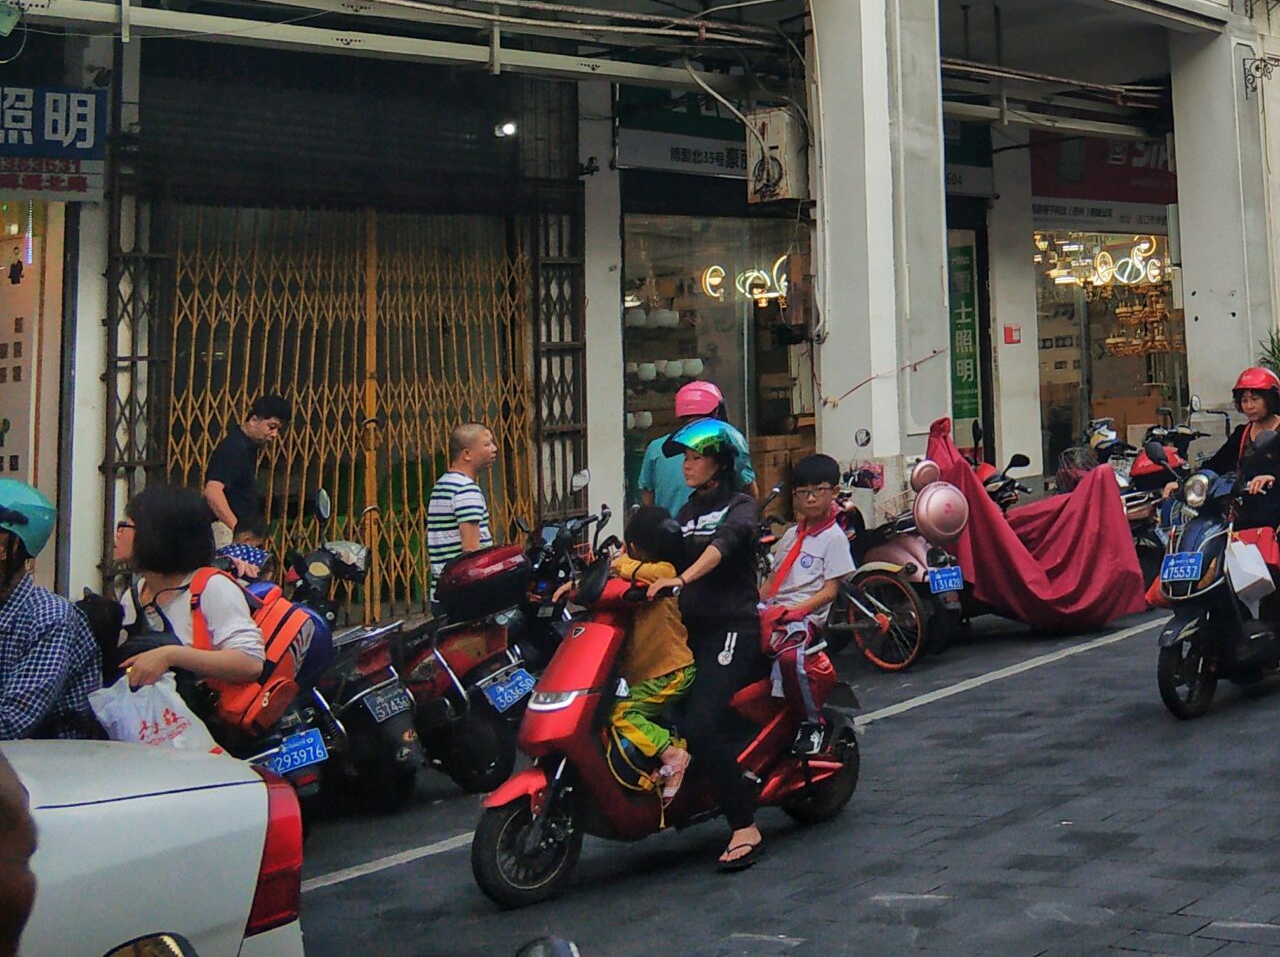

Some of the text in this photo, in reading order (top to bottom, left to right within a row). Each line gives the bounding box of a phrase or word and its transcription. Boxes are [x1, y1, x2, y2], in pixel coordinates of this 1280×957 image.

[0, 87, 97, 150] 照明
[1163, 566, 1199, 579] 475537
[275, 745, 324, 771] 293976
